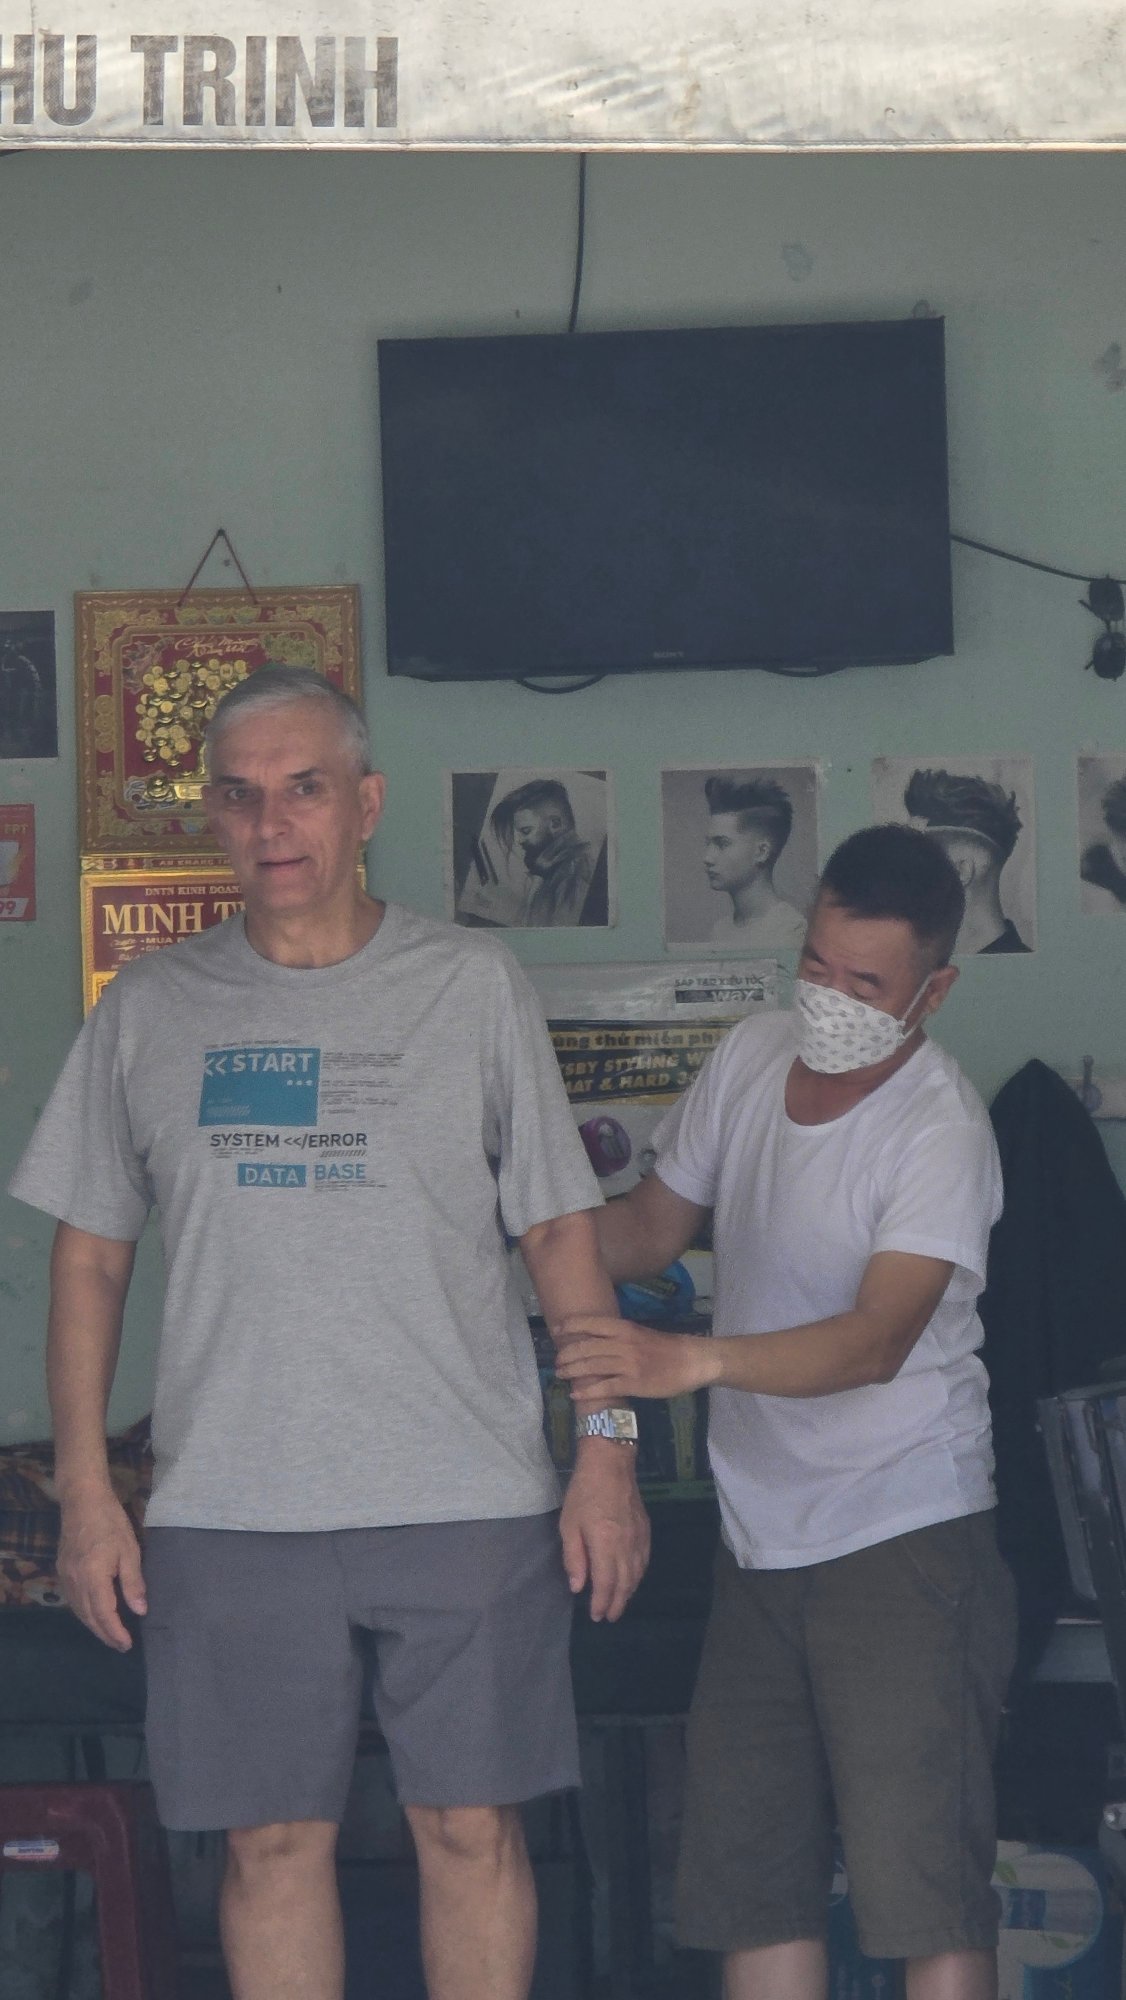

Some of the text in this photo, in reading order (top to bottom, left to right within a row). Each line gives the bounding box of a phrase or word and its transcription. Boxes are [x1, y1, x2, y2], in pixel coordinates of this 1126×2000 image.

[130, 35, 399, 128] TRINH
[102, 901, 246, 935] MINH T
[600, 1077, 613, 1091] &
[619, 1073, 670, 1088] HARD
[209, 1133, 280, 1147] SYSTEM
[244, 1163, 367, 1184] DATA BASE
